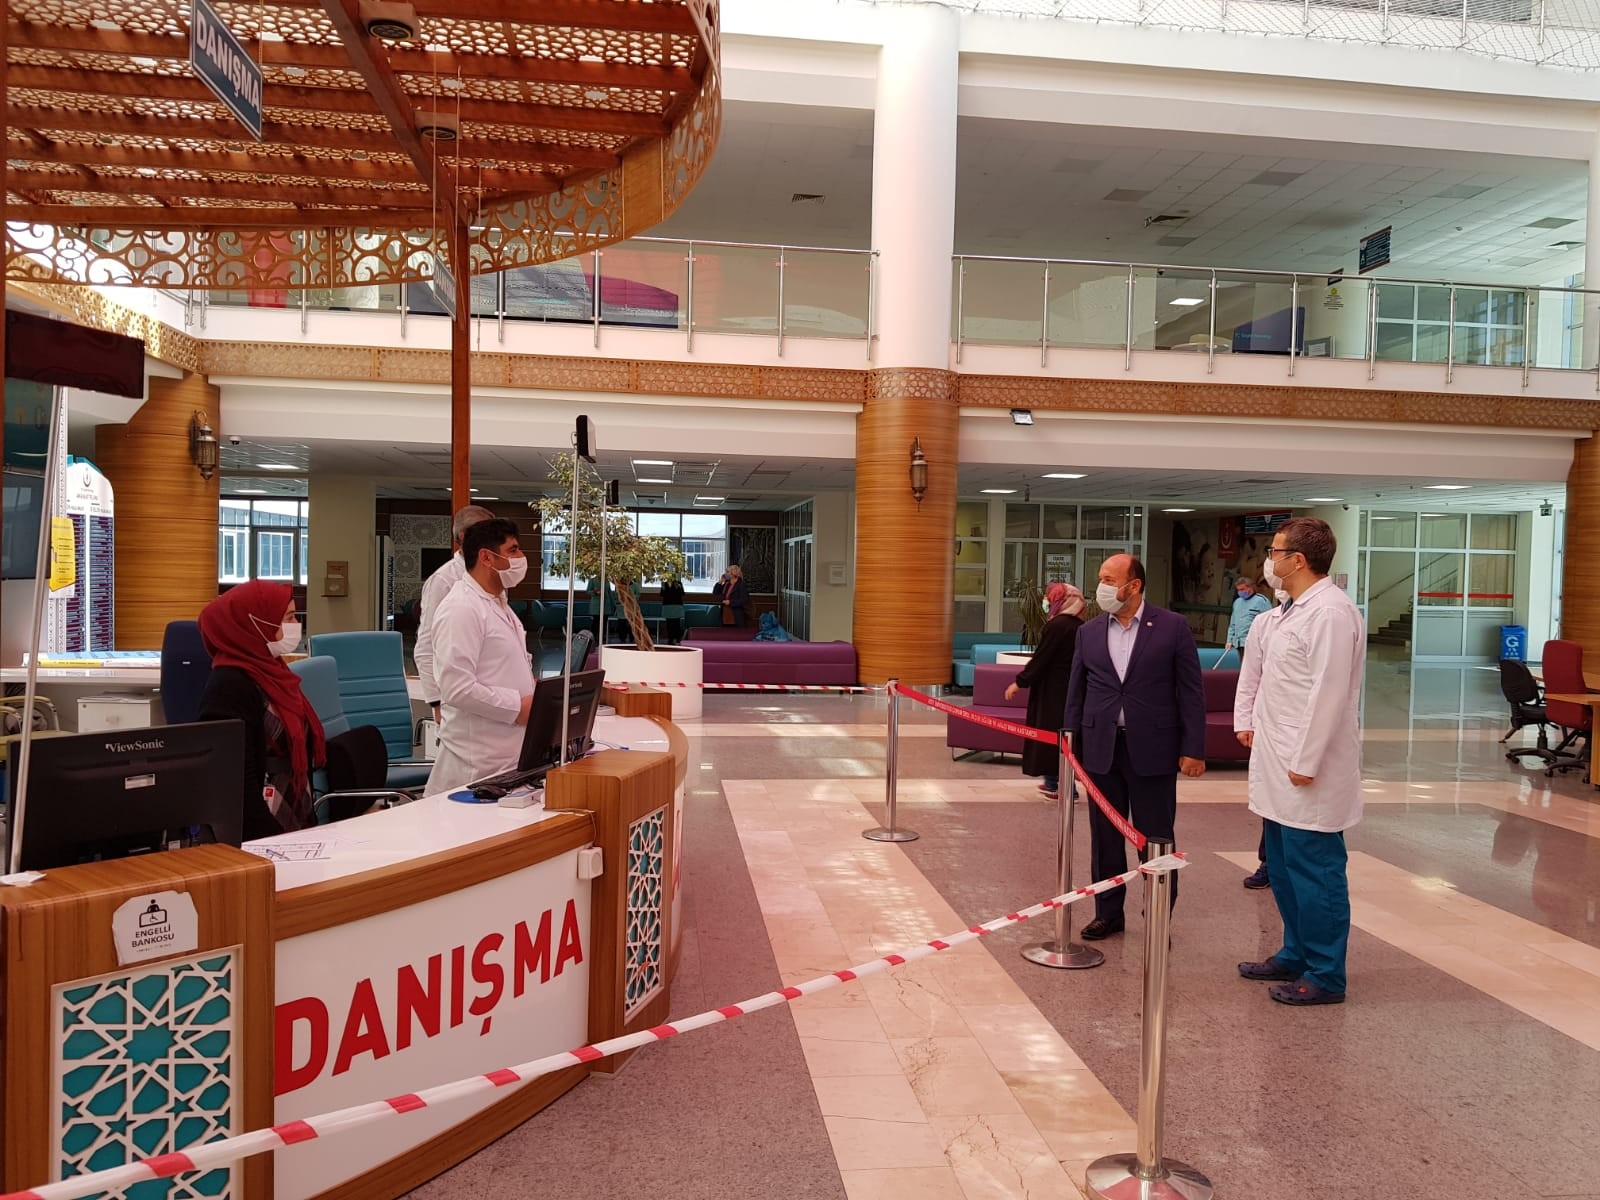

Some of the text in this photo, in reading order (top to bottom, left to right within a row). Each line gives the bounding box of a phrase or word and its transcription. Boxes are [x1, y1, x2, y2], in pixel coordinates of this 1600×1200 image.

[196, 9, 261, 114] DANIŞMA
[107, 738, 165, 753] ViewSonic
[135, 923, 171, 938] ENGELLİ
[131, 933, 175, 948] BANKOSU
[274, 899, 584, 1097] DANIŞMA
